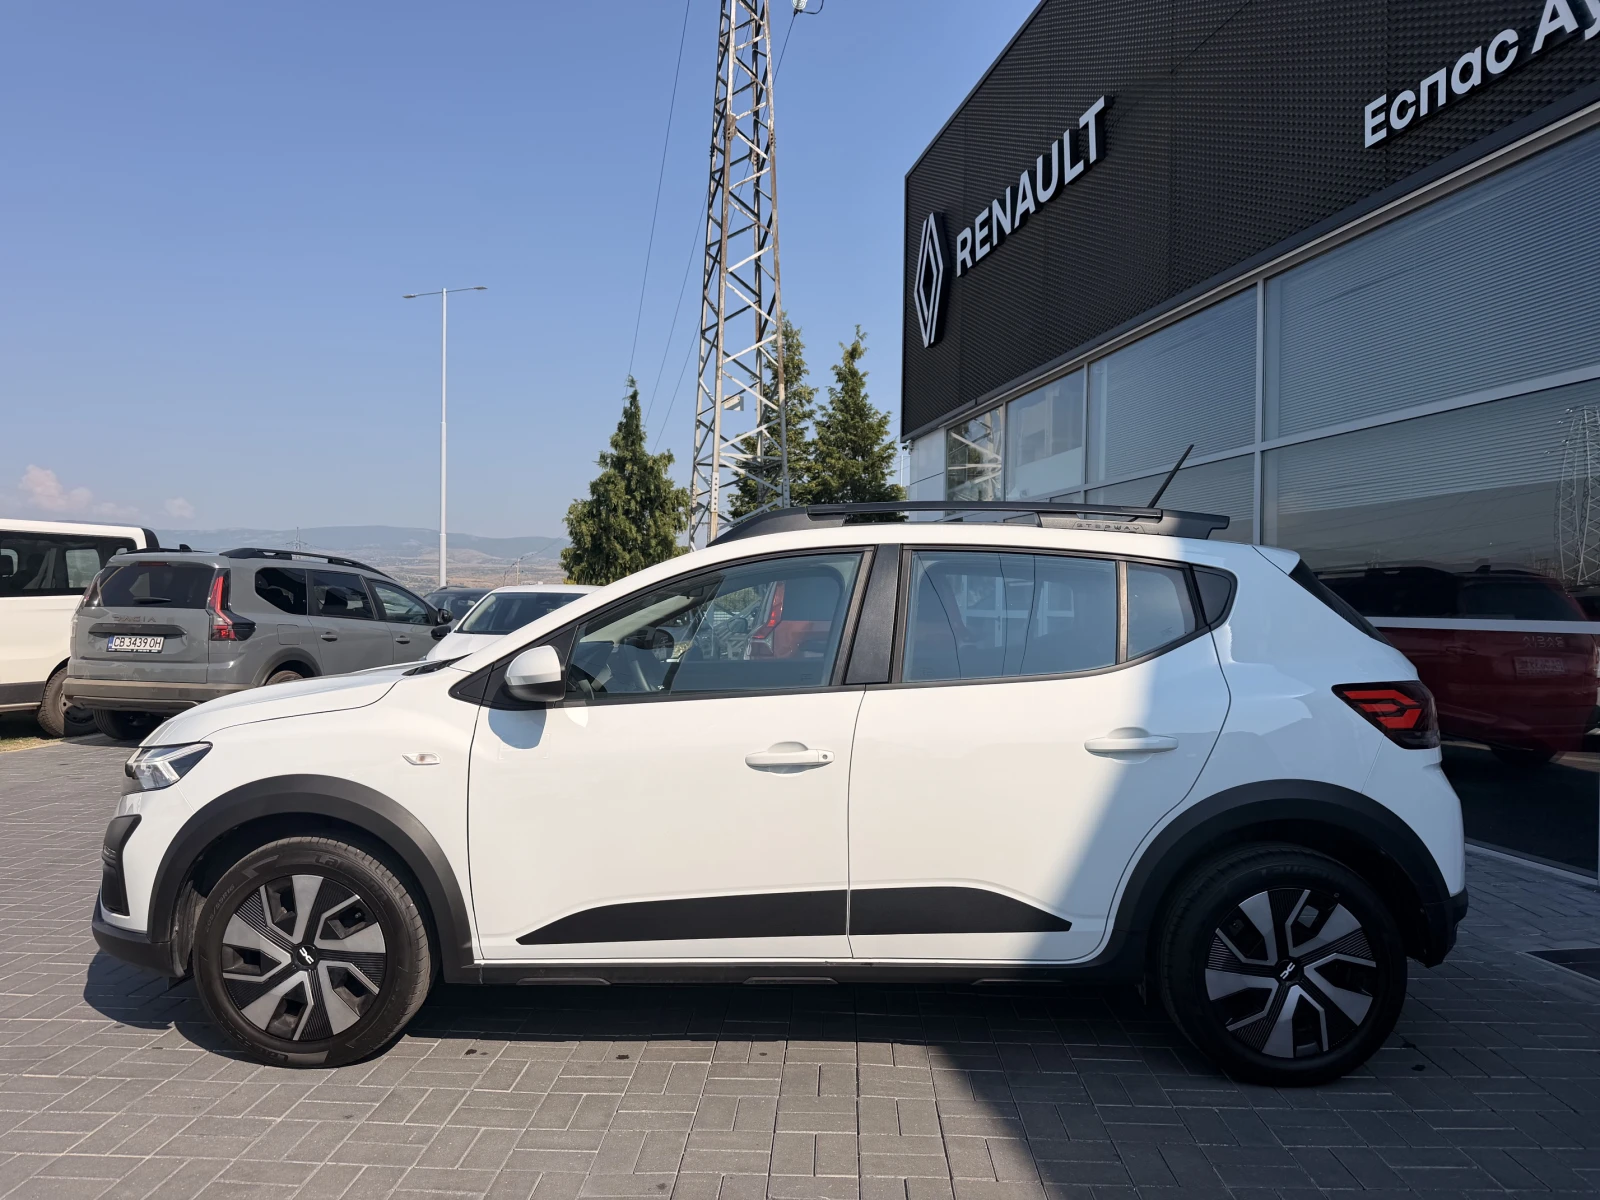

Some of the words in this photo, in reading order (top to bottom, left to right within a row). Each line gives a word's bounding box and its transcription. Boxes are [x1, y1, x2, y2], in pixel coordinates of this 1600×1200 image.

[1365, 28, 1519, 149] Еспас
[956, 94, 1106, 278] RENAULT
[1076, 523, 1140, 531] STEPWAY
[113, 636, 126, 648] CB
[126, 637, 149, 648] 3439
